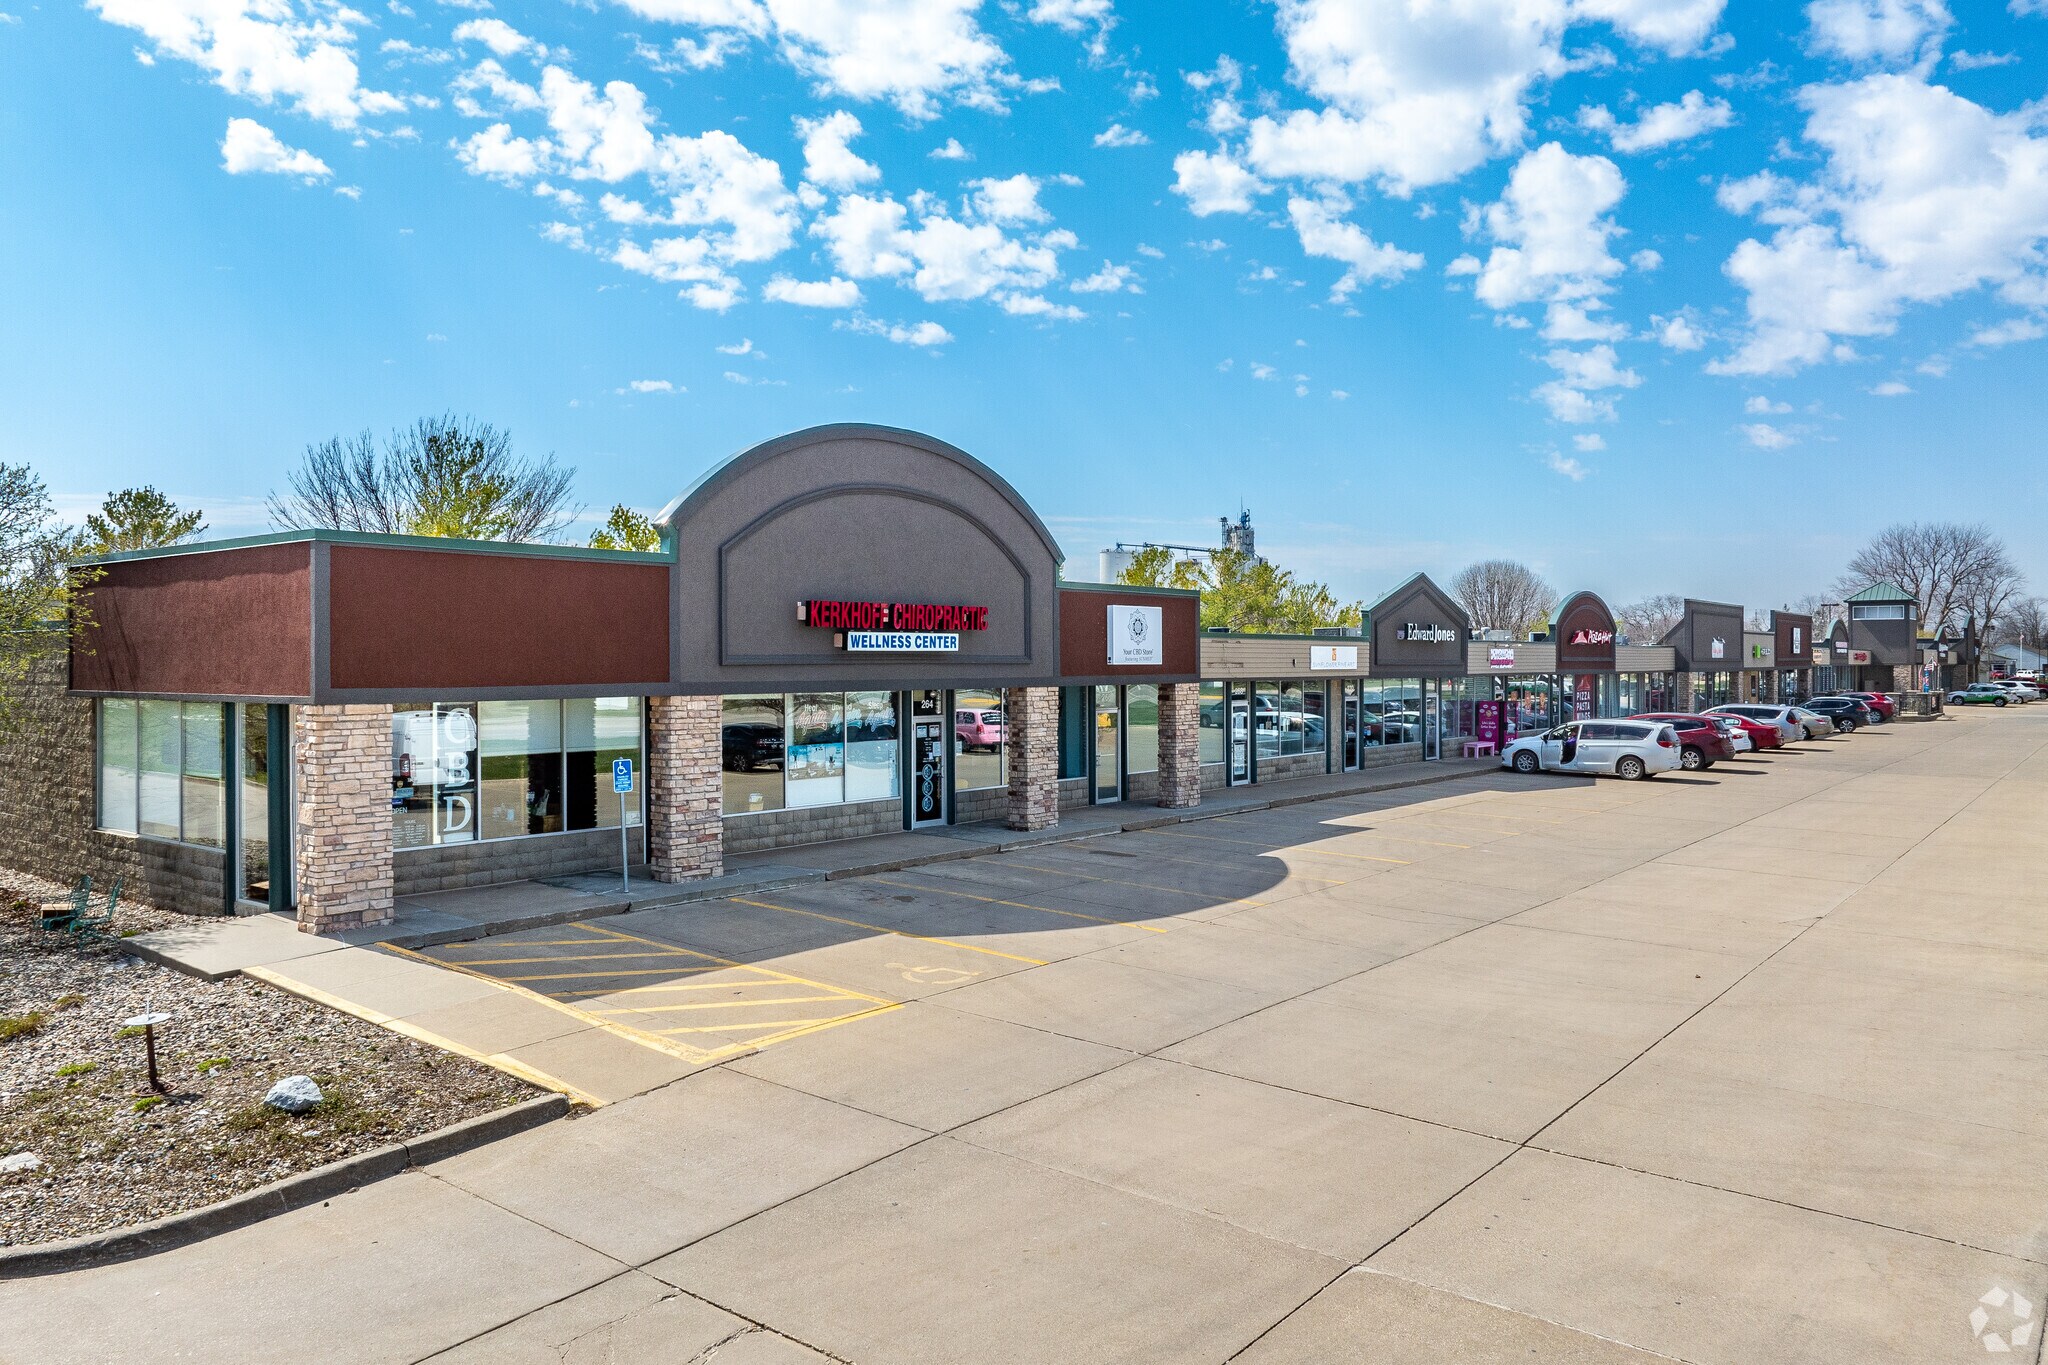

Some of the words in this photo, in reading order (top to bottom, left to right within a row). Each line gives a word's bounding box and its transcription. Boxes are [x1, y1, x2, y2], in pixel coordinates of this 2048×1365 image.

[810, 600, 889, 629] KERKHOFF
[893, 603, 989, 631] CHIROPRACTIC
[1407, 623, 1434, 641] Edward
[1433, 624, 1455, 643] Jones
[850, 634, 912, 649] WELLNESS
[914, 635, 957, 649] CENTER
[1576, 691, 1591, 701] PIZZA
[804, 703, 819, 712] Heal
[921, 699, 934, 709] 264
[1576, 701, 1591, 711] PASTA
